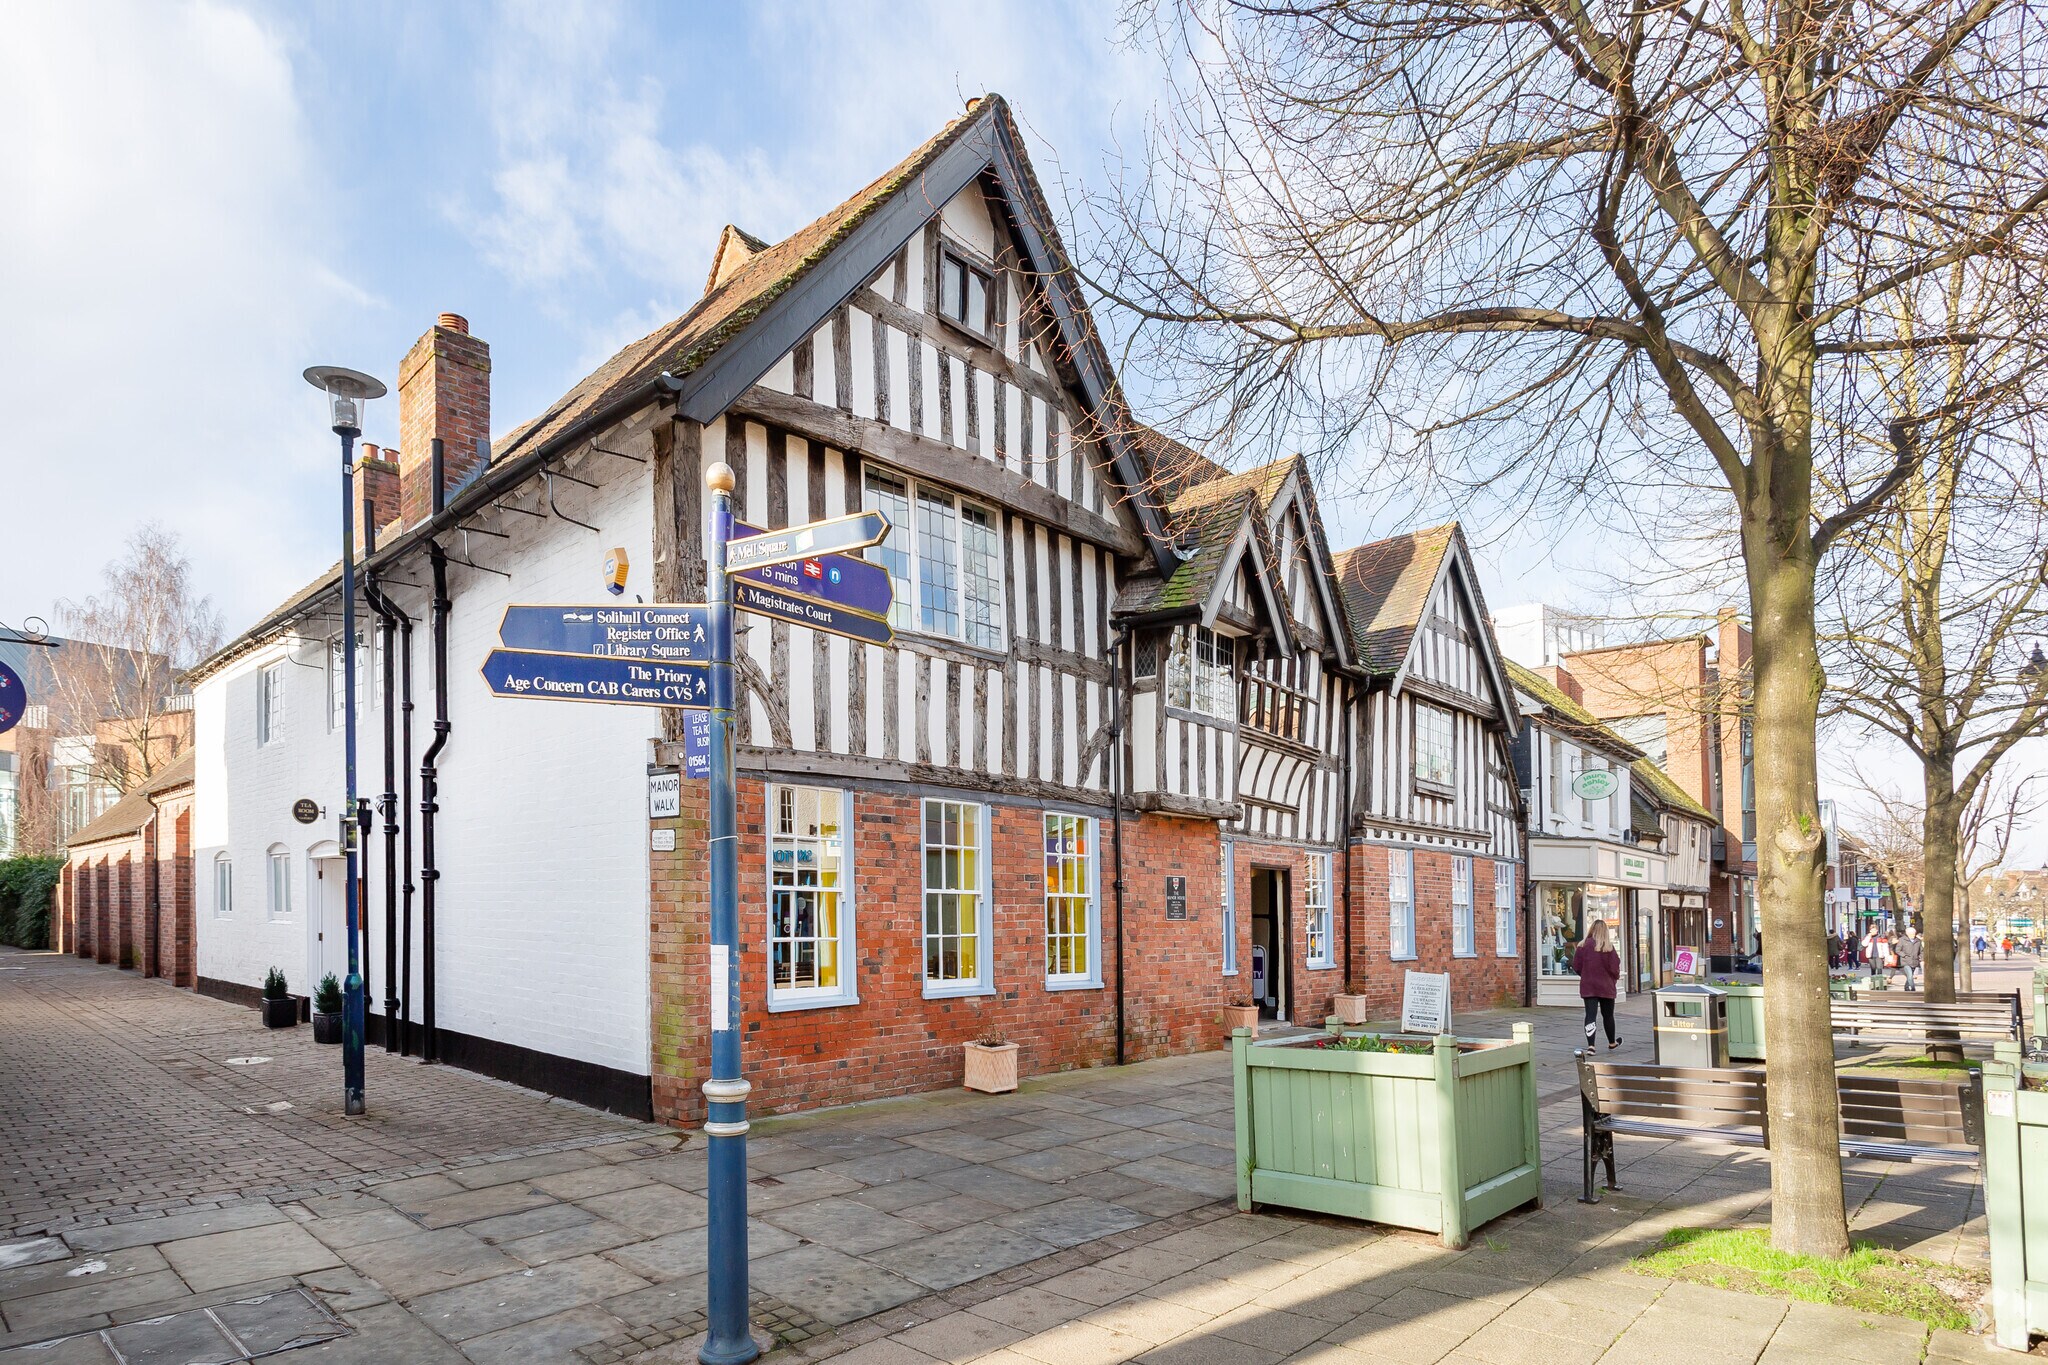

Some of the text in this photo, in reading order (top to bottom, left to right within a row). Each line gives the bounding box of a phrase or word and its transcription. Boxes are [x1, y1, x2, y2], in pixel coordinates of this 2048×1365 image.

[737, 540, 788, 560] Mell Square
[761, 566, 772, 578] 15
[774, 569, 799, 586] mins
[748, 589, 833, 623] Magistrates Court
[597, 611, 690, 624] Solihull Connect
[607, 627, 690, 642] Register Office
[607, 644, 690, 660] Library Square
[628, 666, 692, 686] The Priory
[504, 674, 693, 700] Age Concern CAB Carers CVS
[692, 713, 708, 724] LEASE
[692, 725, 703, 736] TEA
[688, 755, 706, 767] 01564
[1582, 778, 1610, 789] ashley
[1583, 773, 1607, 782] laura
[650, 779, 679, 793] MANOR
[654, 798, 675, 812] WALK
